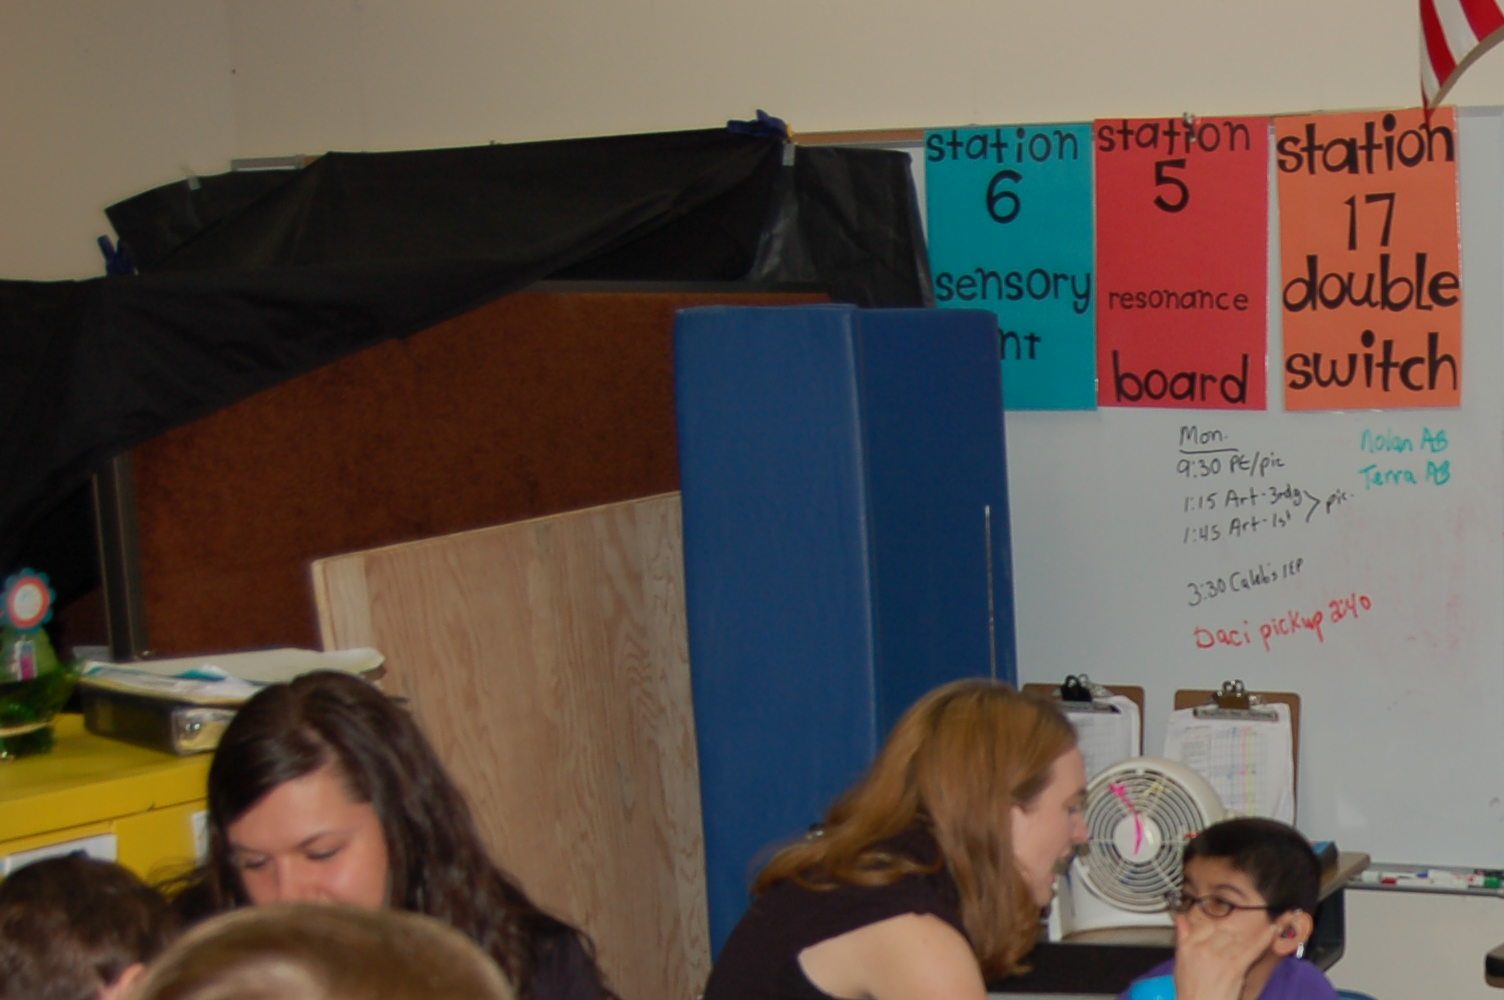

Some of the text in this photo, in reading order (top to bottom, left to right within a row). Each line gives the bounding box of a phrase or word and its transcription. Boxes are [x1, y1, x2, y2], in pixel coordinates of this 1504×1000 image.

[926, 128, 1079, 164] station
[1098, 119, 1250, 156] station
[1277, 112, 1455, 175] station
[985, 169, 1023, 224] 6
[1153, 158, 1190, 213] 5
[1344, 192, 1396, 251] 17
[934, 267, 1091, 315] sensory
[1108, 288, 1249, 312] resonance
[1282, 252, 1460, 313] double
[1111, 349, 1249, 404] board
[1285, 329, 1457, 393] switch
[1175, 456, 1222, 479] 9:30
[1183, 491, 1218, 513] 1:15
[1183, 523, 1221, 544] 1:45
[1186, 577, 1227, 607] 3:30
[1327, 592, 1373, 624] 2:40
